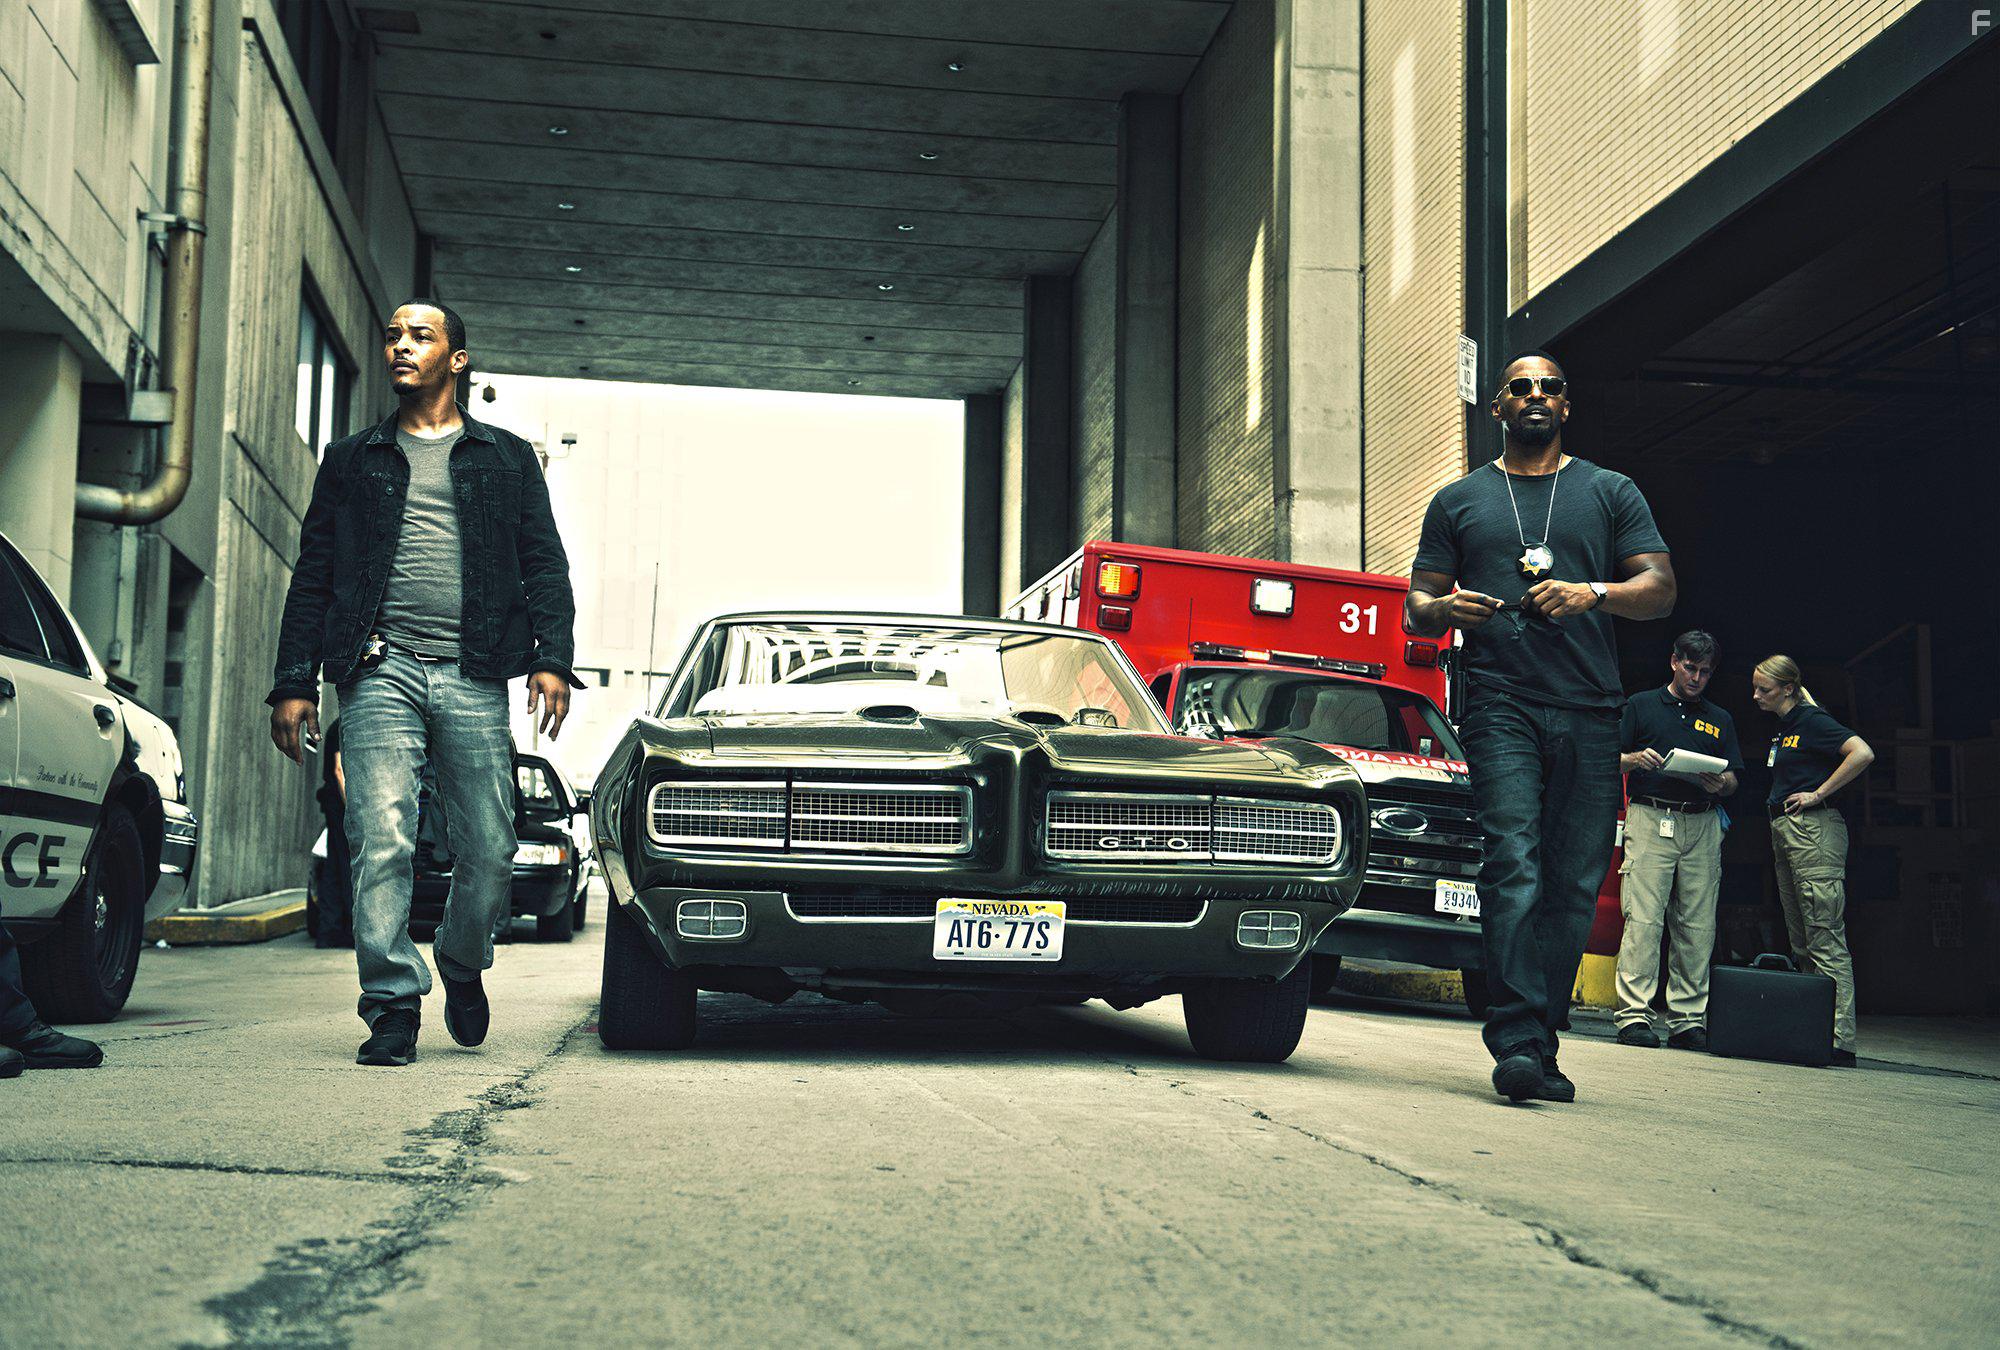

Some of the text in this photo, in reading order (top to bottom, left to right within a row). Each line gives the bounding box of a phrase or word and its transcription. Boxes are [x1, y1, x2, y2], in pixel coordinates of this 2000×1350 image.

[1460, 341, 1475, 357] SPEED
[1460, 354, 1474, 369] LIMIT
[1463, 370, 1471, 385] 10
[1339, 602, 1378, 636] 31
[1694, 718, 1720, 740] CSI
[1098, 836, 1189, 850] GTO
[0, 830, 66, 889] CE
[1453, 883, 1476, 892] NEVAD
[972, 903, 1030, 916] NEVADA
